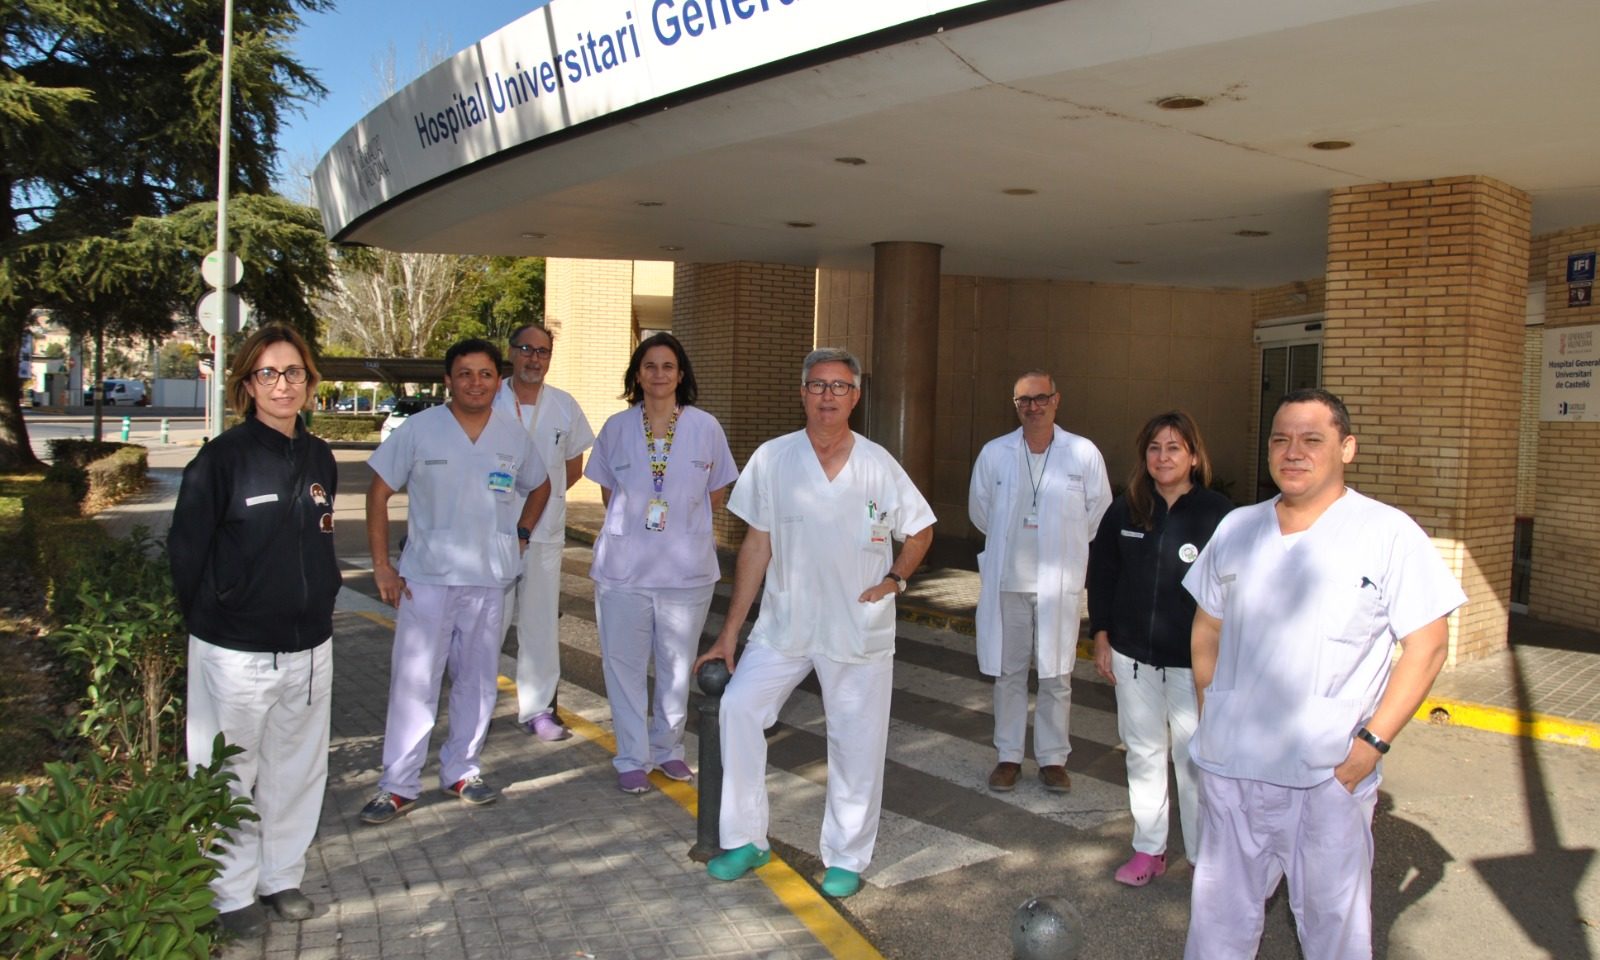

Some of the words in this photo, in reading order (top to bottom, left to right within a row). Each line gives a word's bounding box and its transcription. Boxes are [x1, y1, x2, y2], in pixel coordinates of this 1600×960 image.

[414, 82, 487, 149] Hospital
[485, 11, 641, 115] Universitari
[1549, 360, 1574, 369] Hospital
[1575, 358, 1600, 367] General
[1555, 369, 1592, 378] Universitari
[1564, 380, 1590, 389] Castelló
